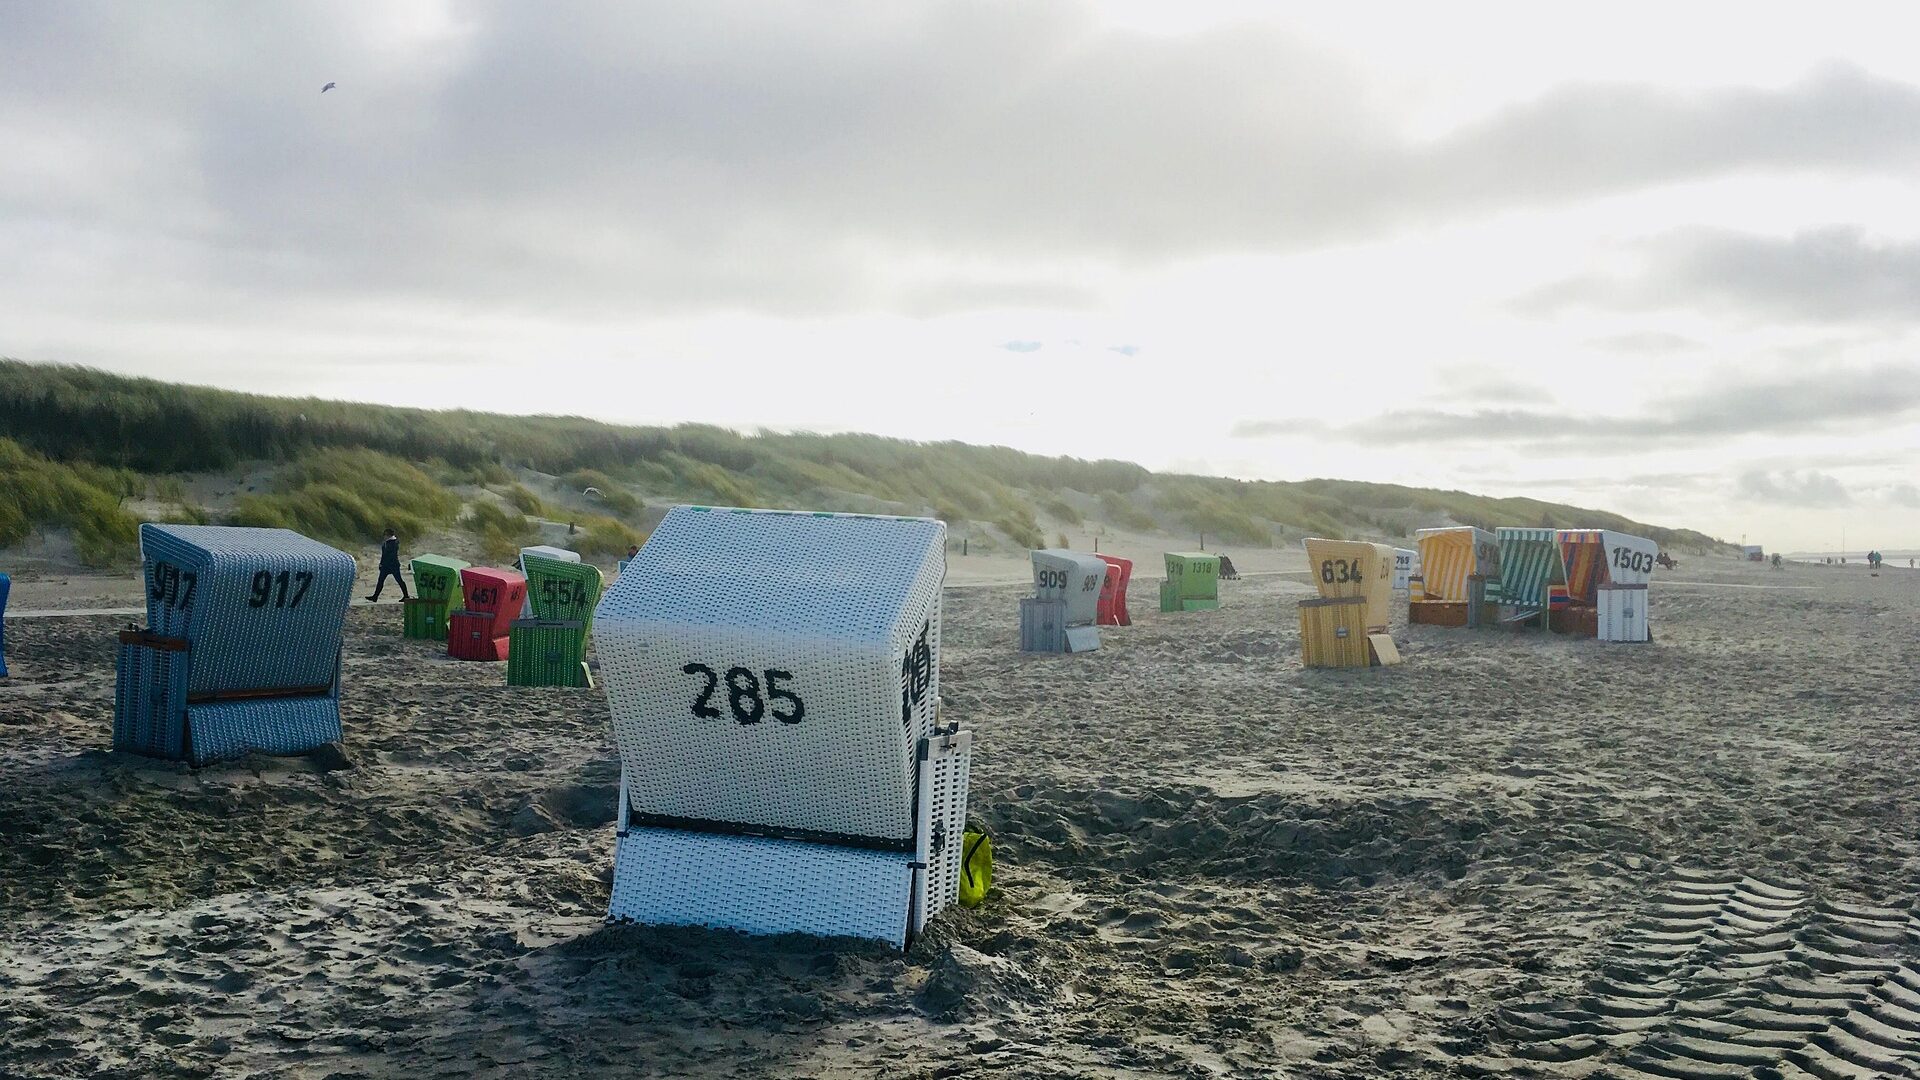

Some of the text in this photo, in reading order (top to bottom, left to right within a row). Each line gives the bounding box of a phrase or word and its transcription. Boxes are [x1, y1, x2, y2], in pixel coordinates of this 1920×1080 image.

[1192, 561, 1213, 574] 1318
[1321, 559, 1363, 584] 634
[1613, 547, 1653, 574] 1503
[153, 561, 198, 611] 917
[249, 569, 313, 608] 917
[1040, 569, 1068, 589] 909
[544, 579, 587, 608] 554
[683, 662, 804, 724] 285
